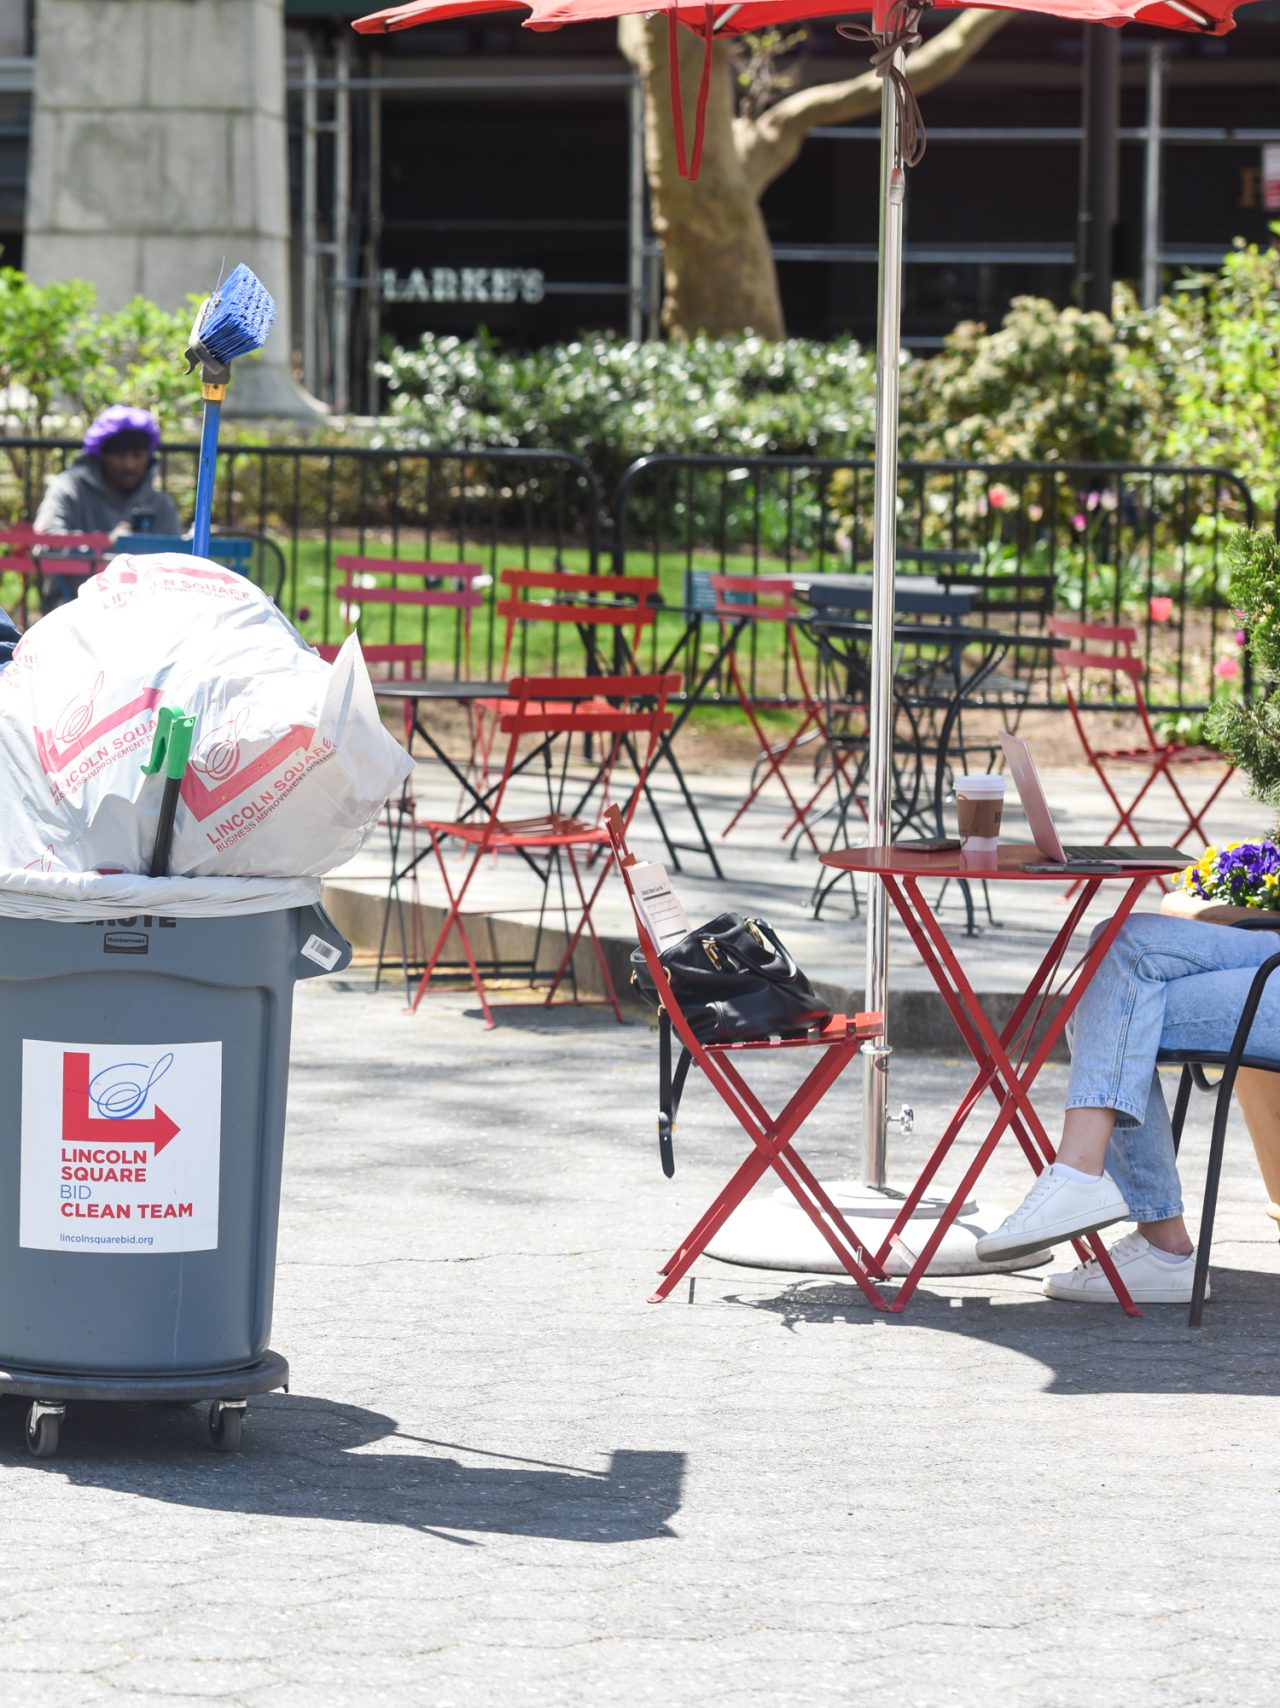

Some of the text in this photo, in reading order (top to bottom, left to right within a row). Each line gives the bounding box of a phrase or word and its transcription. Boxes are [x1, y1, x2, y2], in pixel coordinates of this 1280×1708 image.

[206, 736, 332, 845] LINCOLN SQUARE
[216, 821, 257, 853] BUSINESS
[255, 773, 306, 823] IMPROVEMENT
[61, 1148, 147, 1164] LINCOLN
[61, 1166, 147, 1182] SQUARE
[60, 1184, 91, 1199] BID
[61, 1203, 193, 1218] CLEAN TEAM
[60, 1233, 154, 1245] lincolnsquarebid.org
